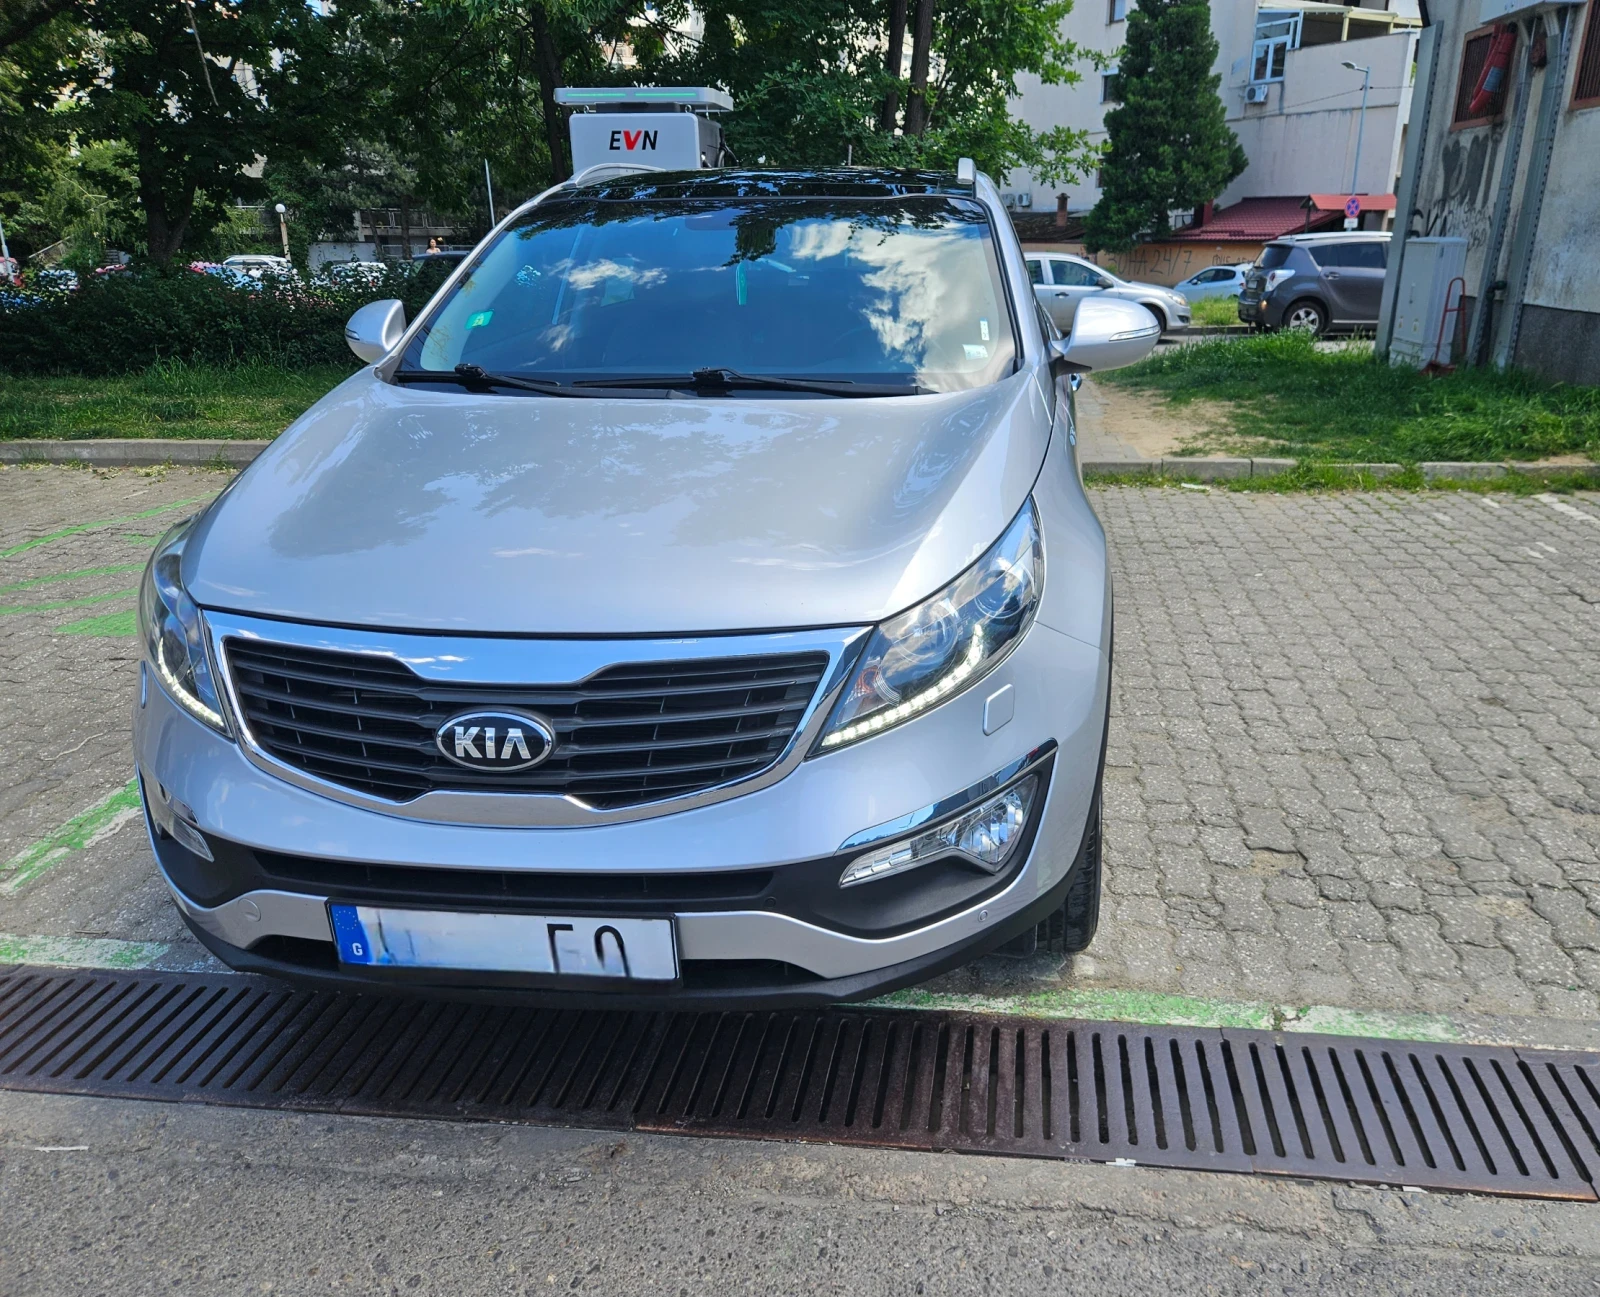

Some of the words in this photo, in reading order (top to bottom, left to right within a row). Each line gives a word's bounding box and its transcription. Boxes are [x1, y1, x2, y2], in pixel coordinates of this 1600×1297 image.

[609, 130, 658, 151] EVN
[1150, 246, 1193, 276] 24/7
[454, 726, 532, 760] KIA
